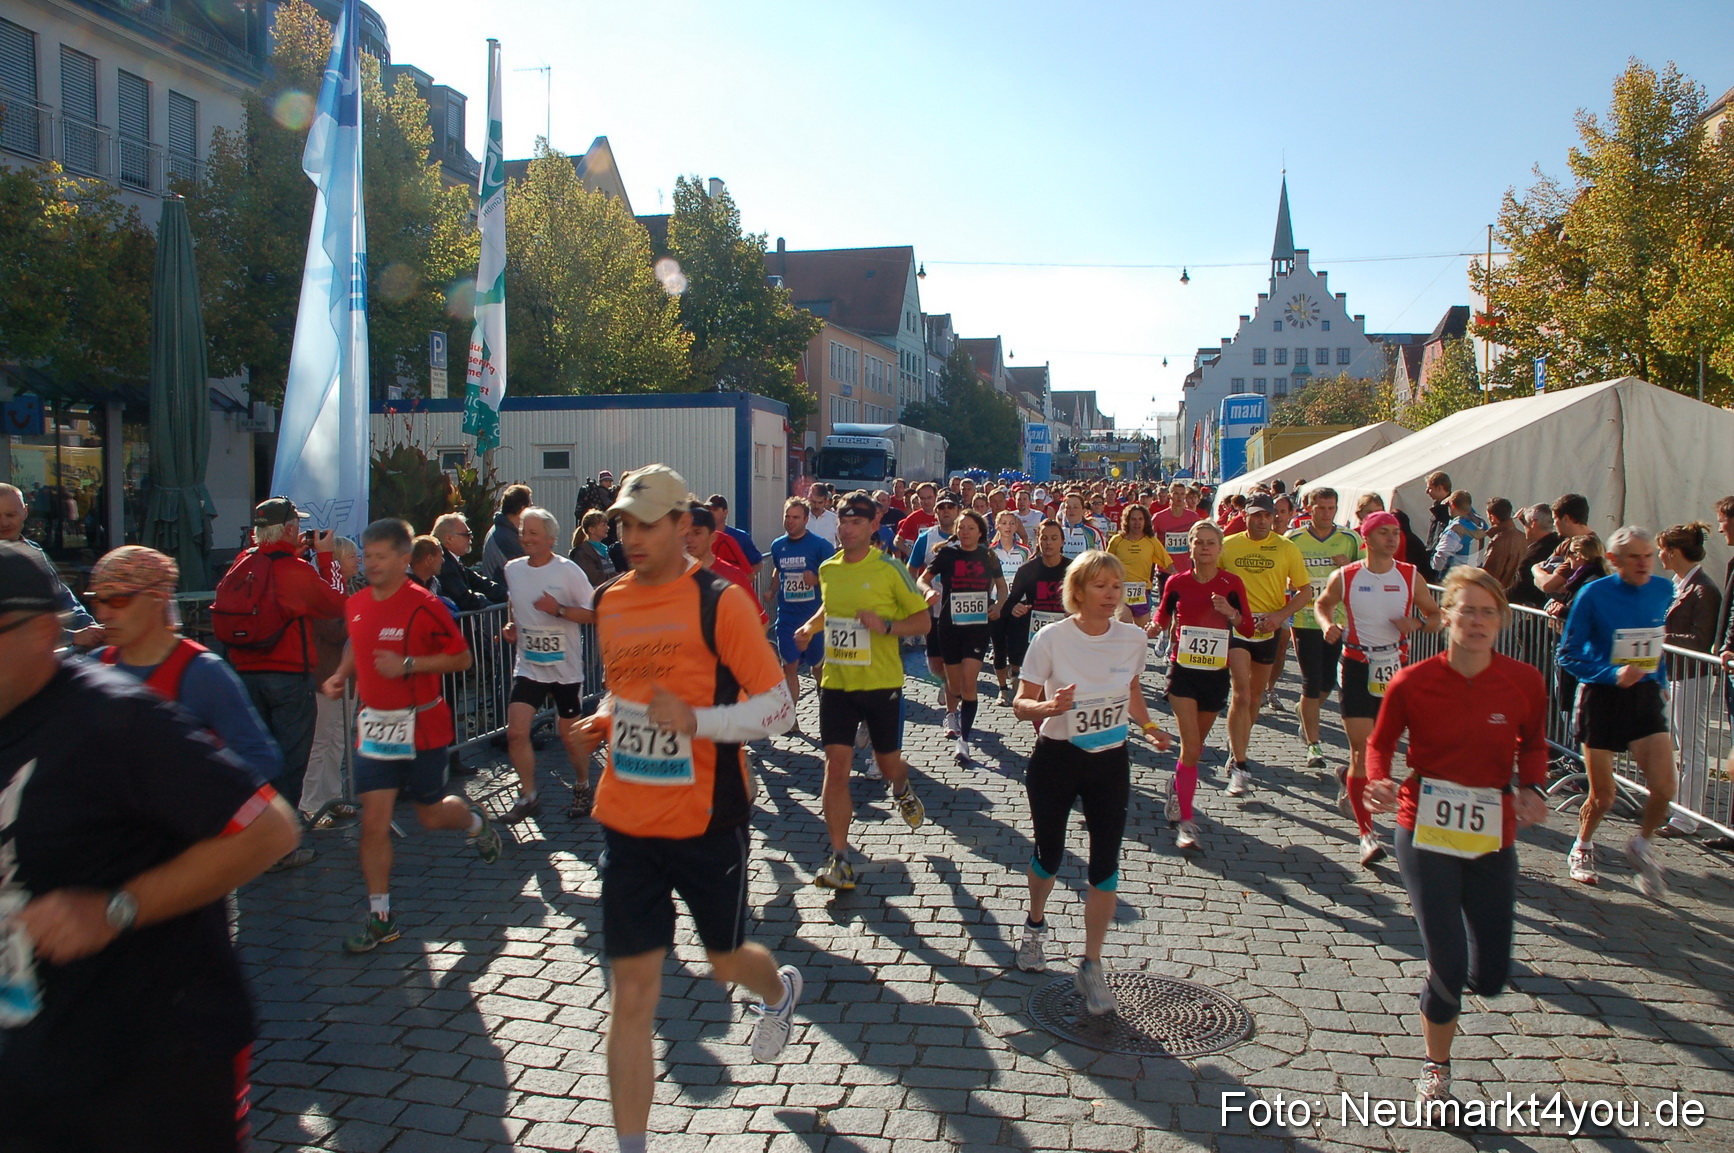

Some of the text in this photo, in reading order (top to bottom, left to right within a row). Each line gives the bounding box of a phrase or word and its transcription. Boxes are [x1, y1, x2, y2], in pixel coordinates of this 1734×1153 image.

[434, 336, 443, 362] P
[1230, 401, 1262, 420] maxi
[1168, 537, 1187, 546] 3114
[1126, 587, 1142, 597] 578
[955, 600, 984, 614] 3556
[525, 636, 561, 652] 3483
[831, 630, 857, 648] 521
[1189, 638, 1219, 655] 437
[1631, 640, 1651, 658] 11
[1189, 654, 1215, 665] Isabel
[1076, 704, 1125, 734] 3467
[365, 721, 409, 743] 2375
[616, 720, 680, 757] 2573
[1435, 799, 1485, 833] 915
